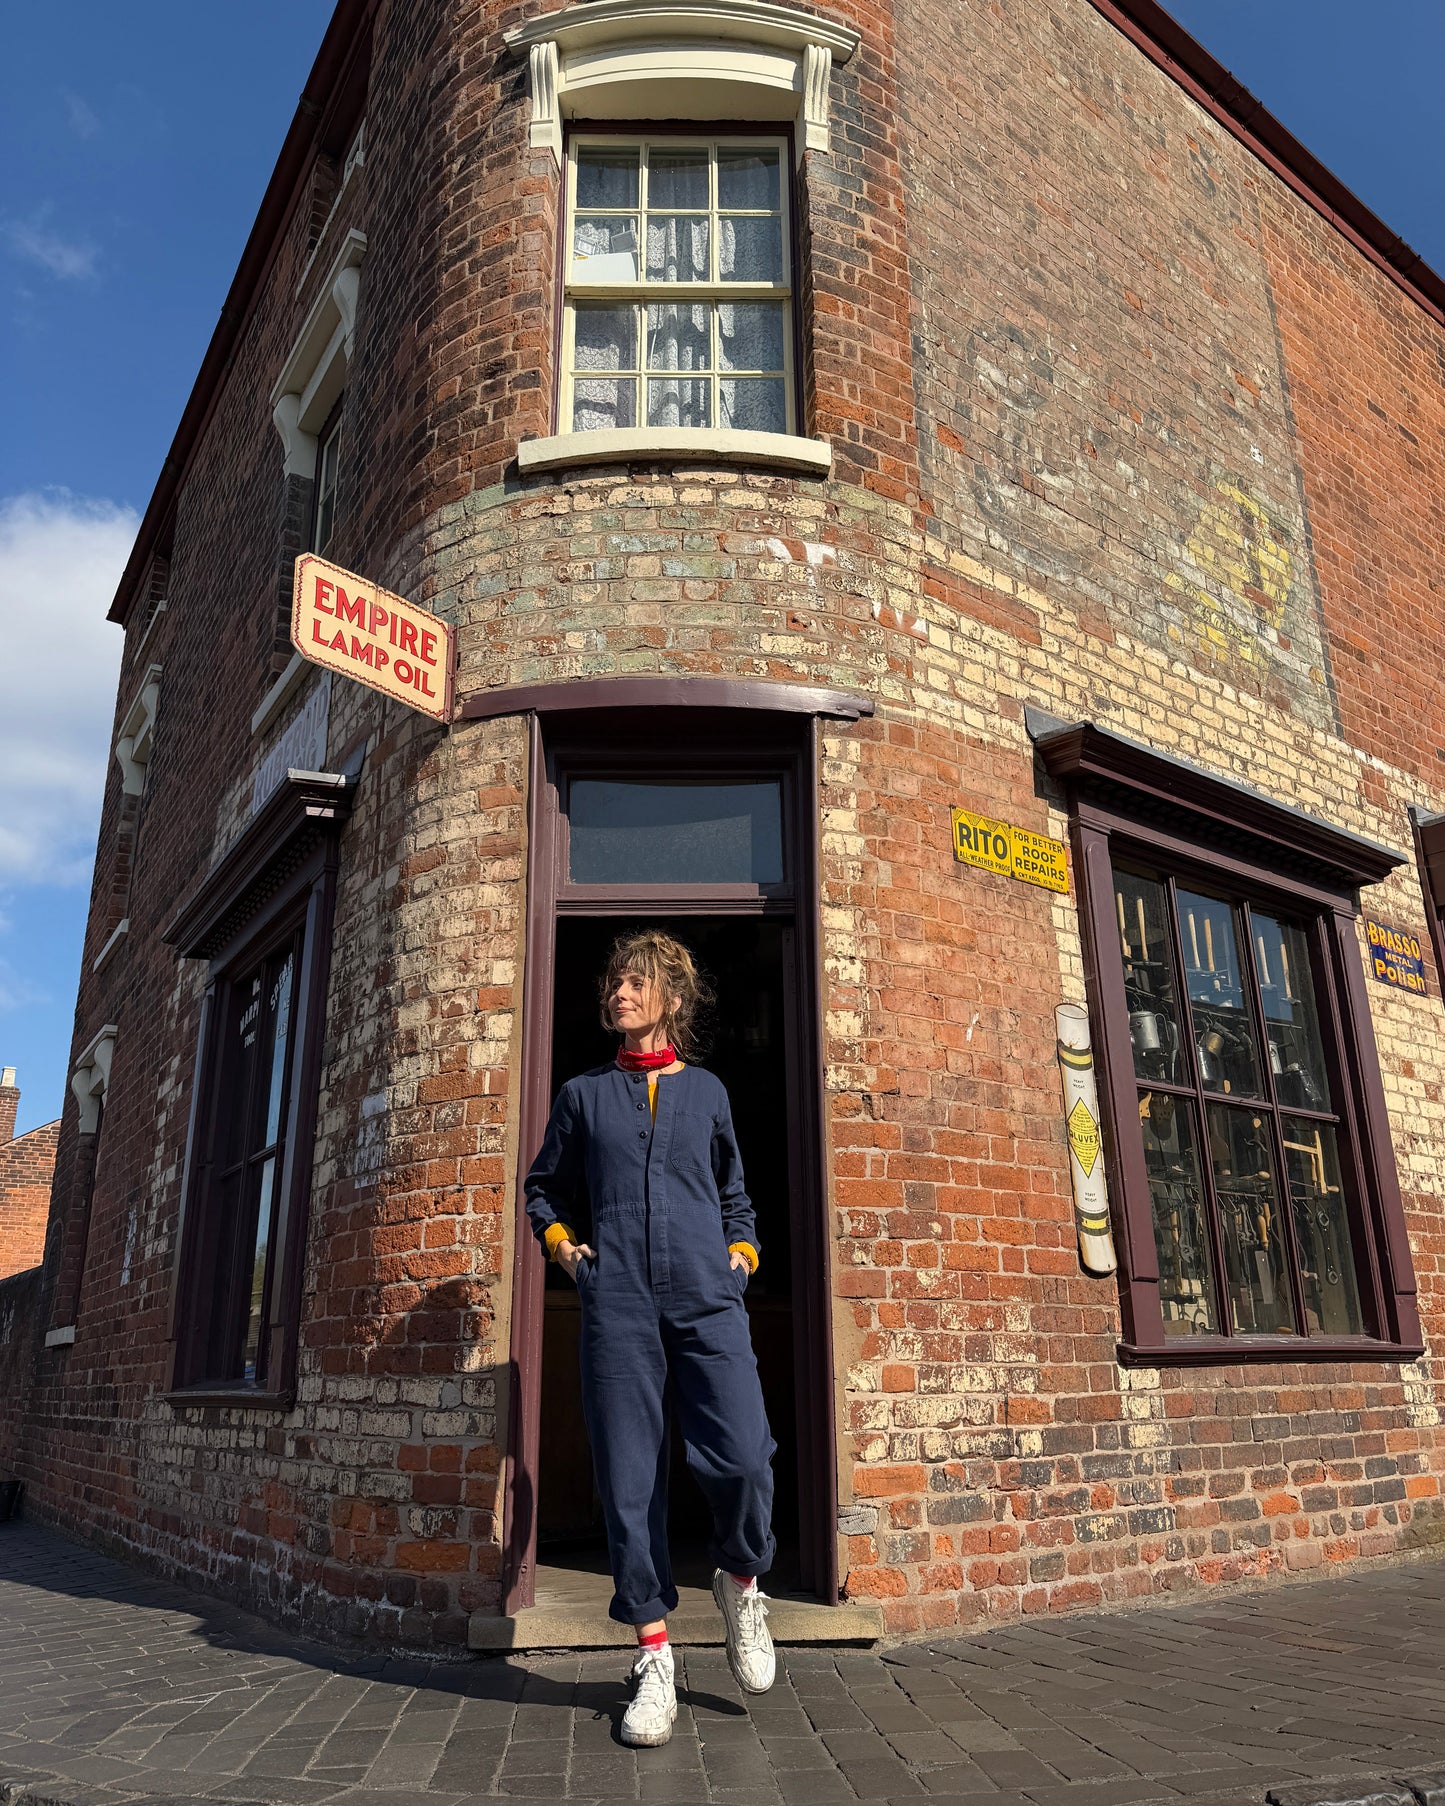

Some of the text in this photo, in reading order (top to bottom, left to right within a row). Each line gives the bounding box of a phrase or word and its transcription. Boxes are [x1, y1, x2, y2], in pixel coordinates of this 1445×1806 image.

[313, 576, 438, 667] EMPIRE
[312, 618, 436, 698] LAMP OIL
[958, 822, 1008, 860] RITO
[1014, 831, 1063, 855] FOR BETTER
[959, 850, 1011, 873] ALL-WEATHER PROOF
[1022, 845, 1057, 865] ROOF
[1015, 857, 1066, 882] REPAIRS
[1368, 921, 1422, 960] BRASSO
[1385, 951, 1413, 969] METAL
[1374, 958, 1427, 994] Polish
[1069, 1129, 1099, 1144] ALUVEX
